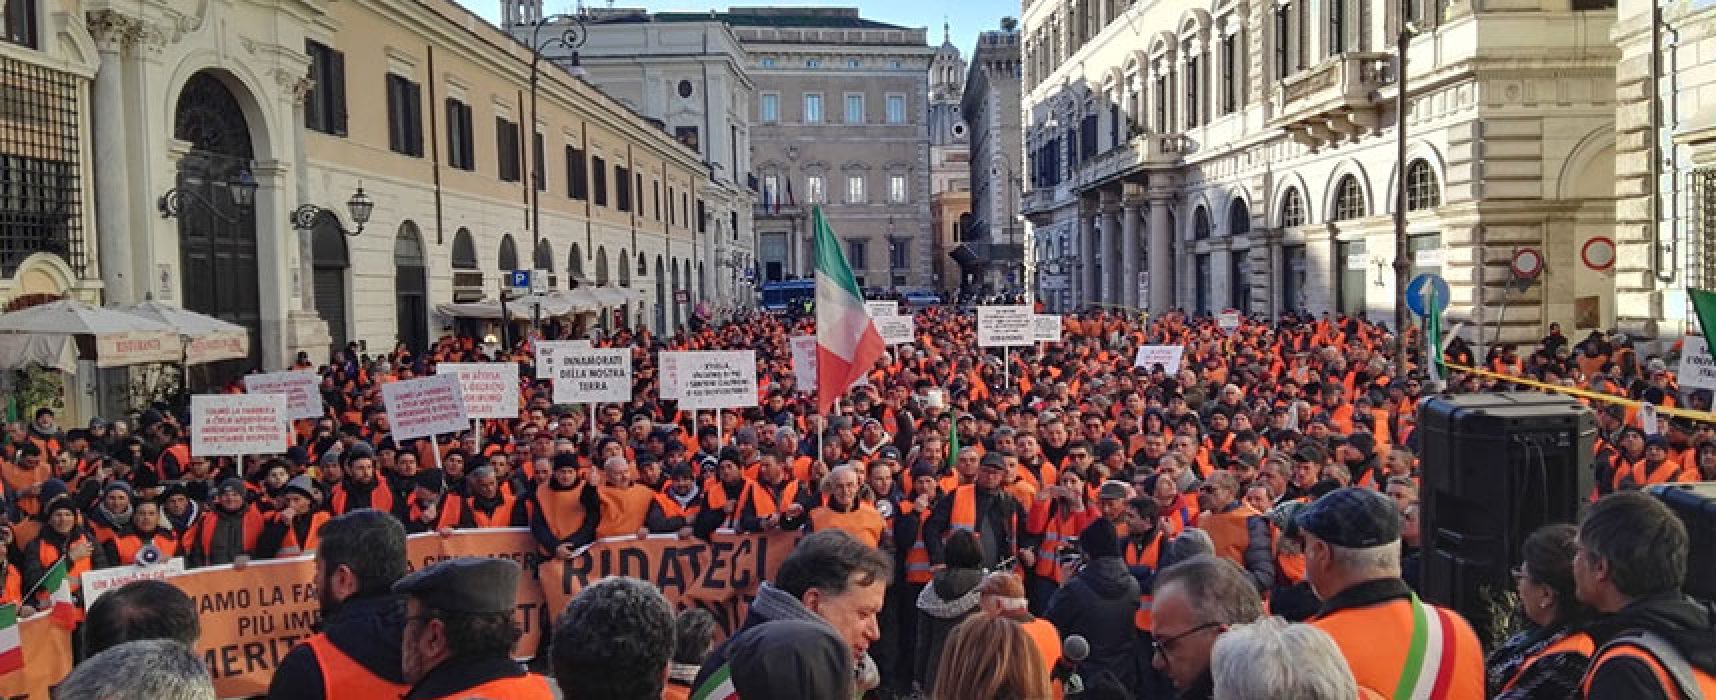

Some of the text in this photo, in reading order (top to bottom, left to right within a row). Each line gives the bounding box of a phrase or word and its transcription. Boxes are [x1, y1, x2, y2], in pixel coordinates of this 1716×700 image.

[515, 273, 526, 286] P
[563, 355, 623, 367] INNAMORATI
[559, 368, 626, 379] DELLA NOSTRA
[579, 381, 609, 391] TERRA
[562, 536, 767, 595] RIDATECI
[258, 585, 284, 607] LA
[292, 583, 319, 603] FA
[238, 609, 321, 636] PIÙ IMP
